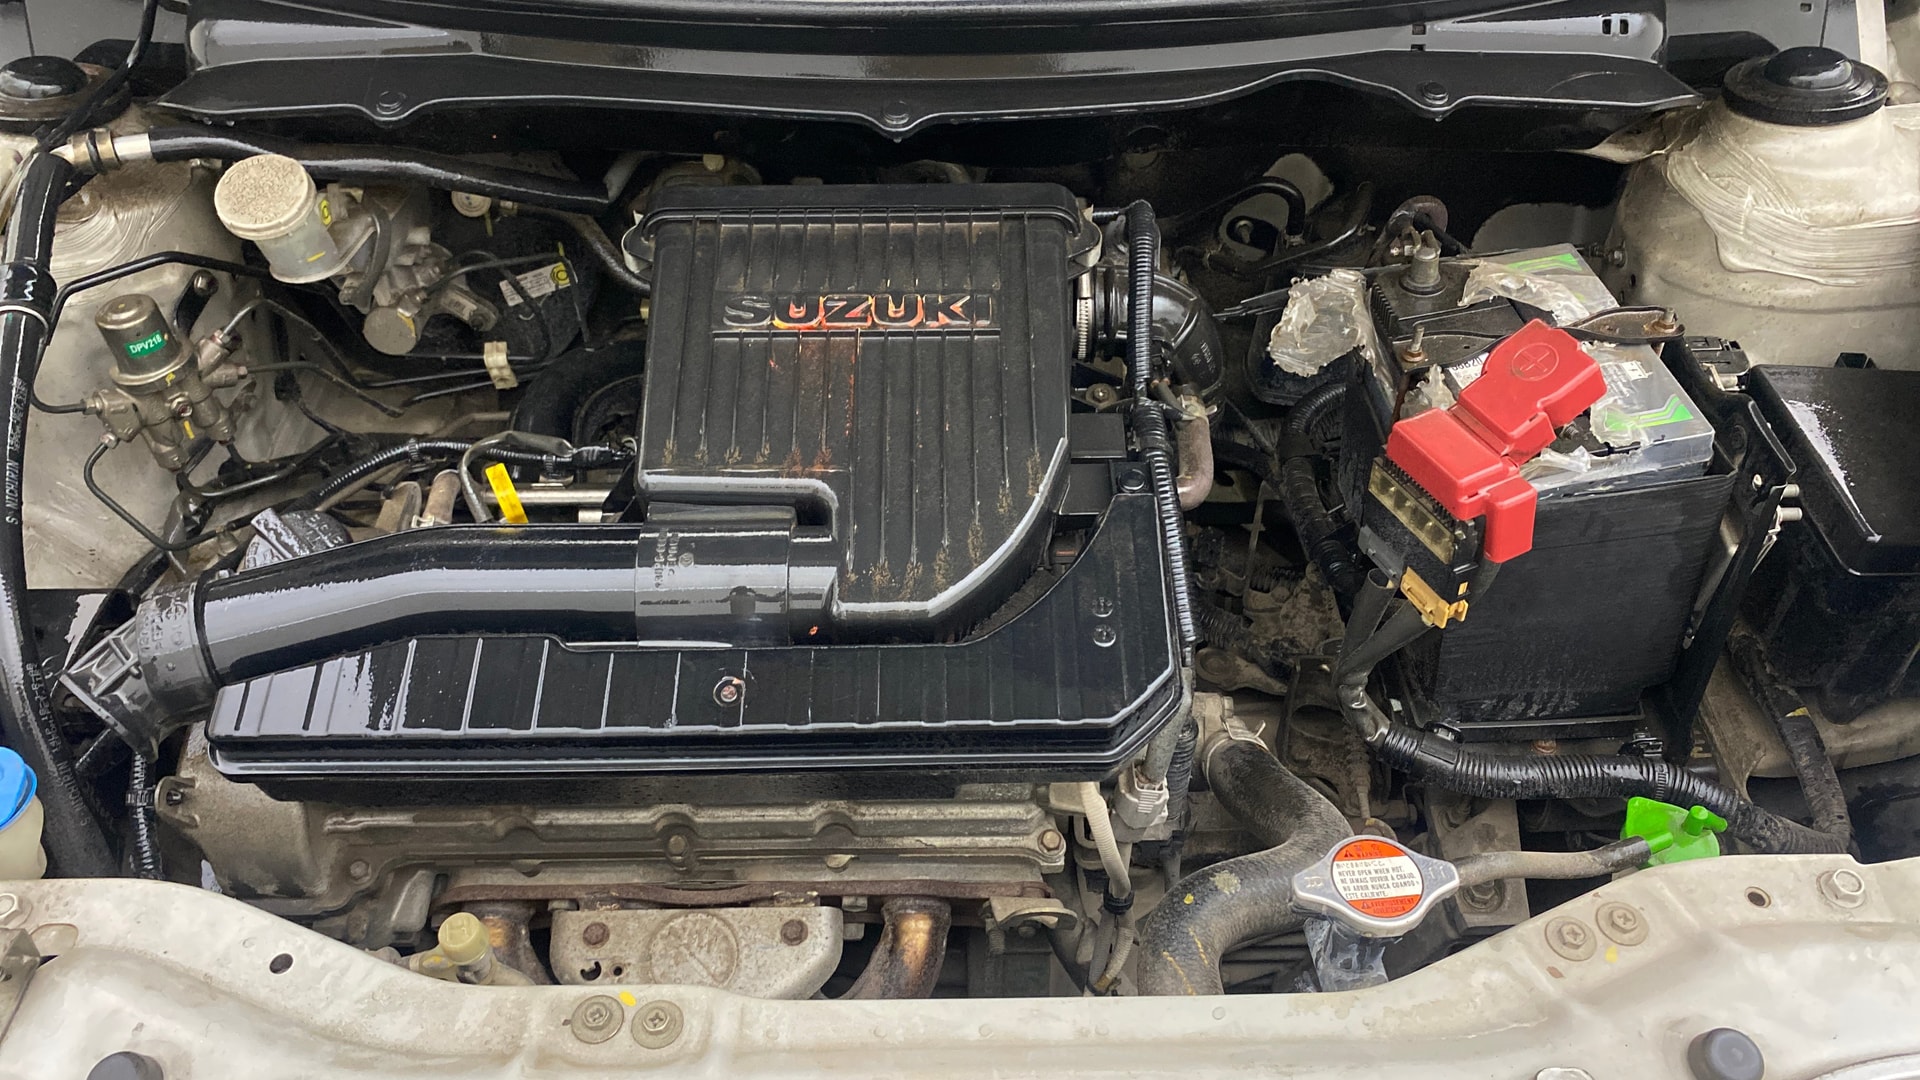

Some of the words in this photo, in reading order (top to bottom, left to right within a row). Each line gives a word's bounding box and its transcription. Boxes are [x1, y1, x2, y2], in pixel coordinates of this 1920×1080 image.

[723, 295, 992, 330] SUZUKI
[1358, 868, 1372, 876] OPEN
[1374, 867, 1390, 875] WHEN
[1349, 876, 1369, 884] JAMAIS
[1371, 882, 1390, 890] NUNCA
